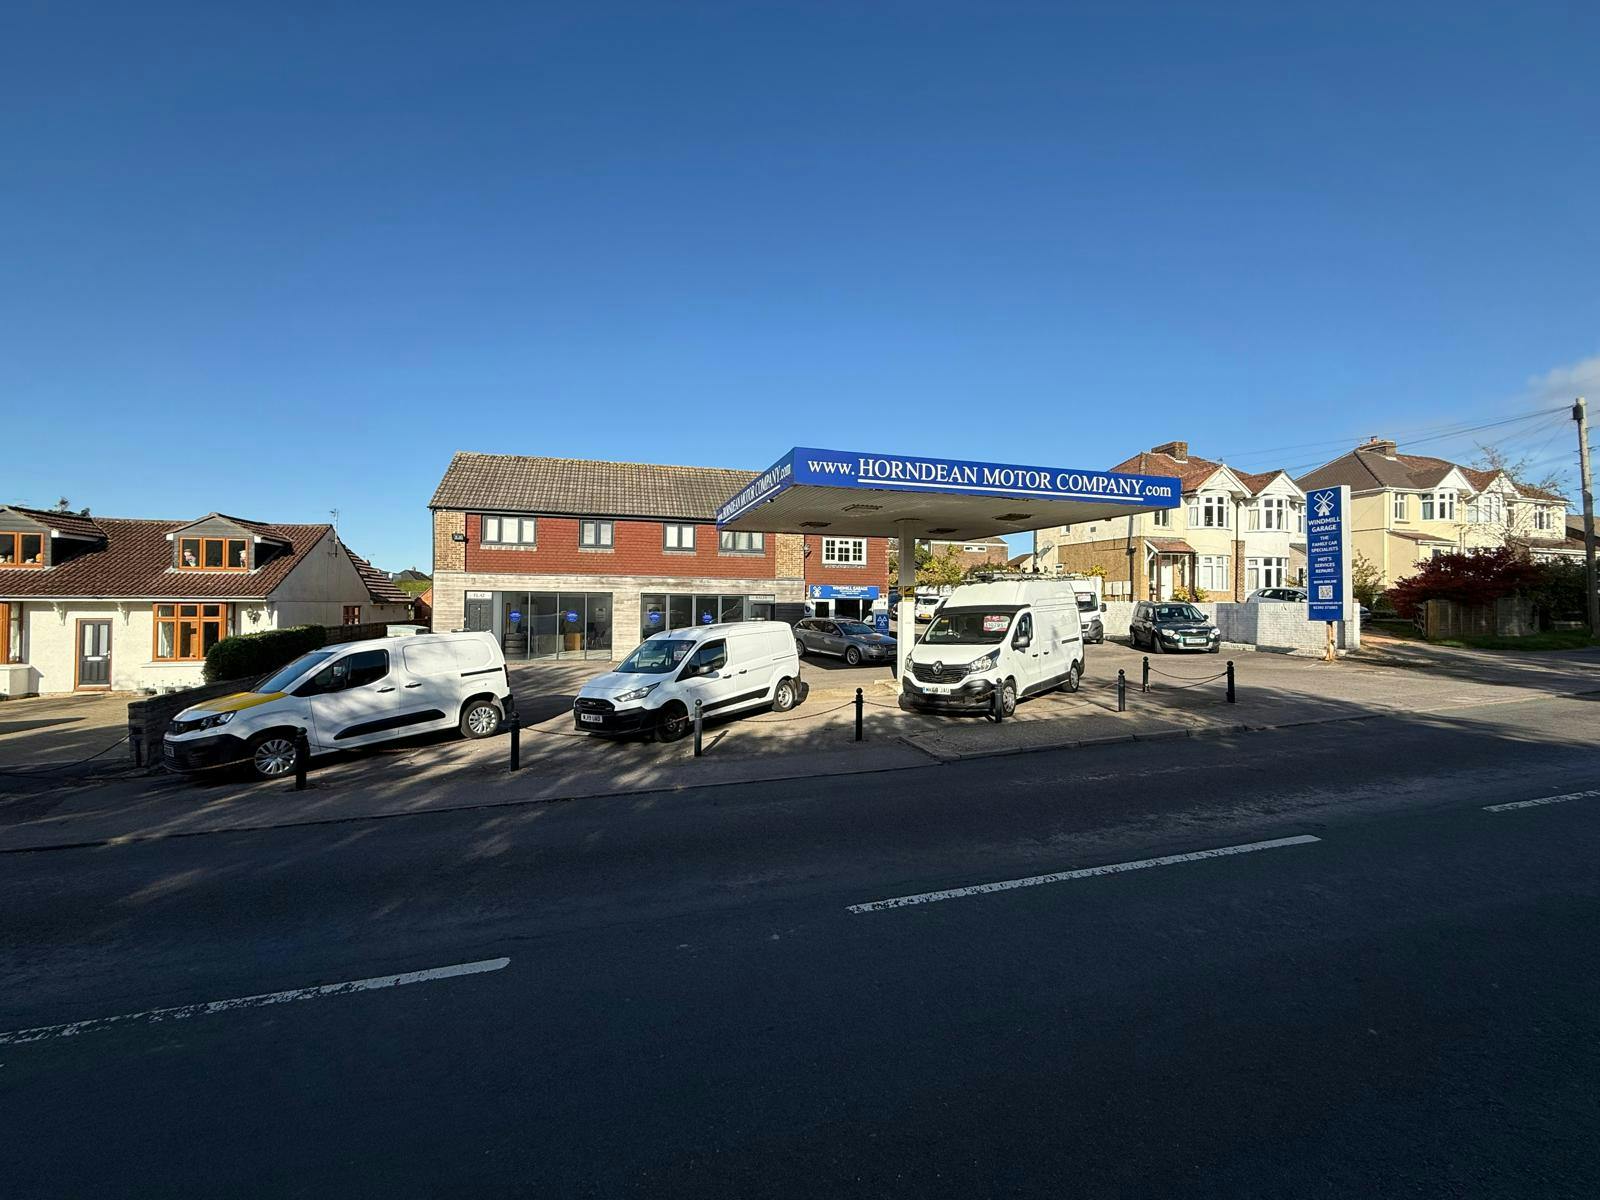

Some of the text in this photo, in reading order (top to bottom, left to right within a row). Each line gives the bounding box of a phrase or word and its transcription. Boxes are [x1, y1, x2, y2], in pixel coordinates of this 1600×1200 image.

[808, 458, 1172, 497] www. HORNDEAN MOTOR COMPANY.com
[1308, 516, 1341, 526] WINDMILL
[1311, 524, 1337, 533] GARAGE
